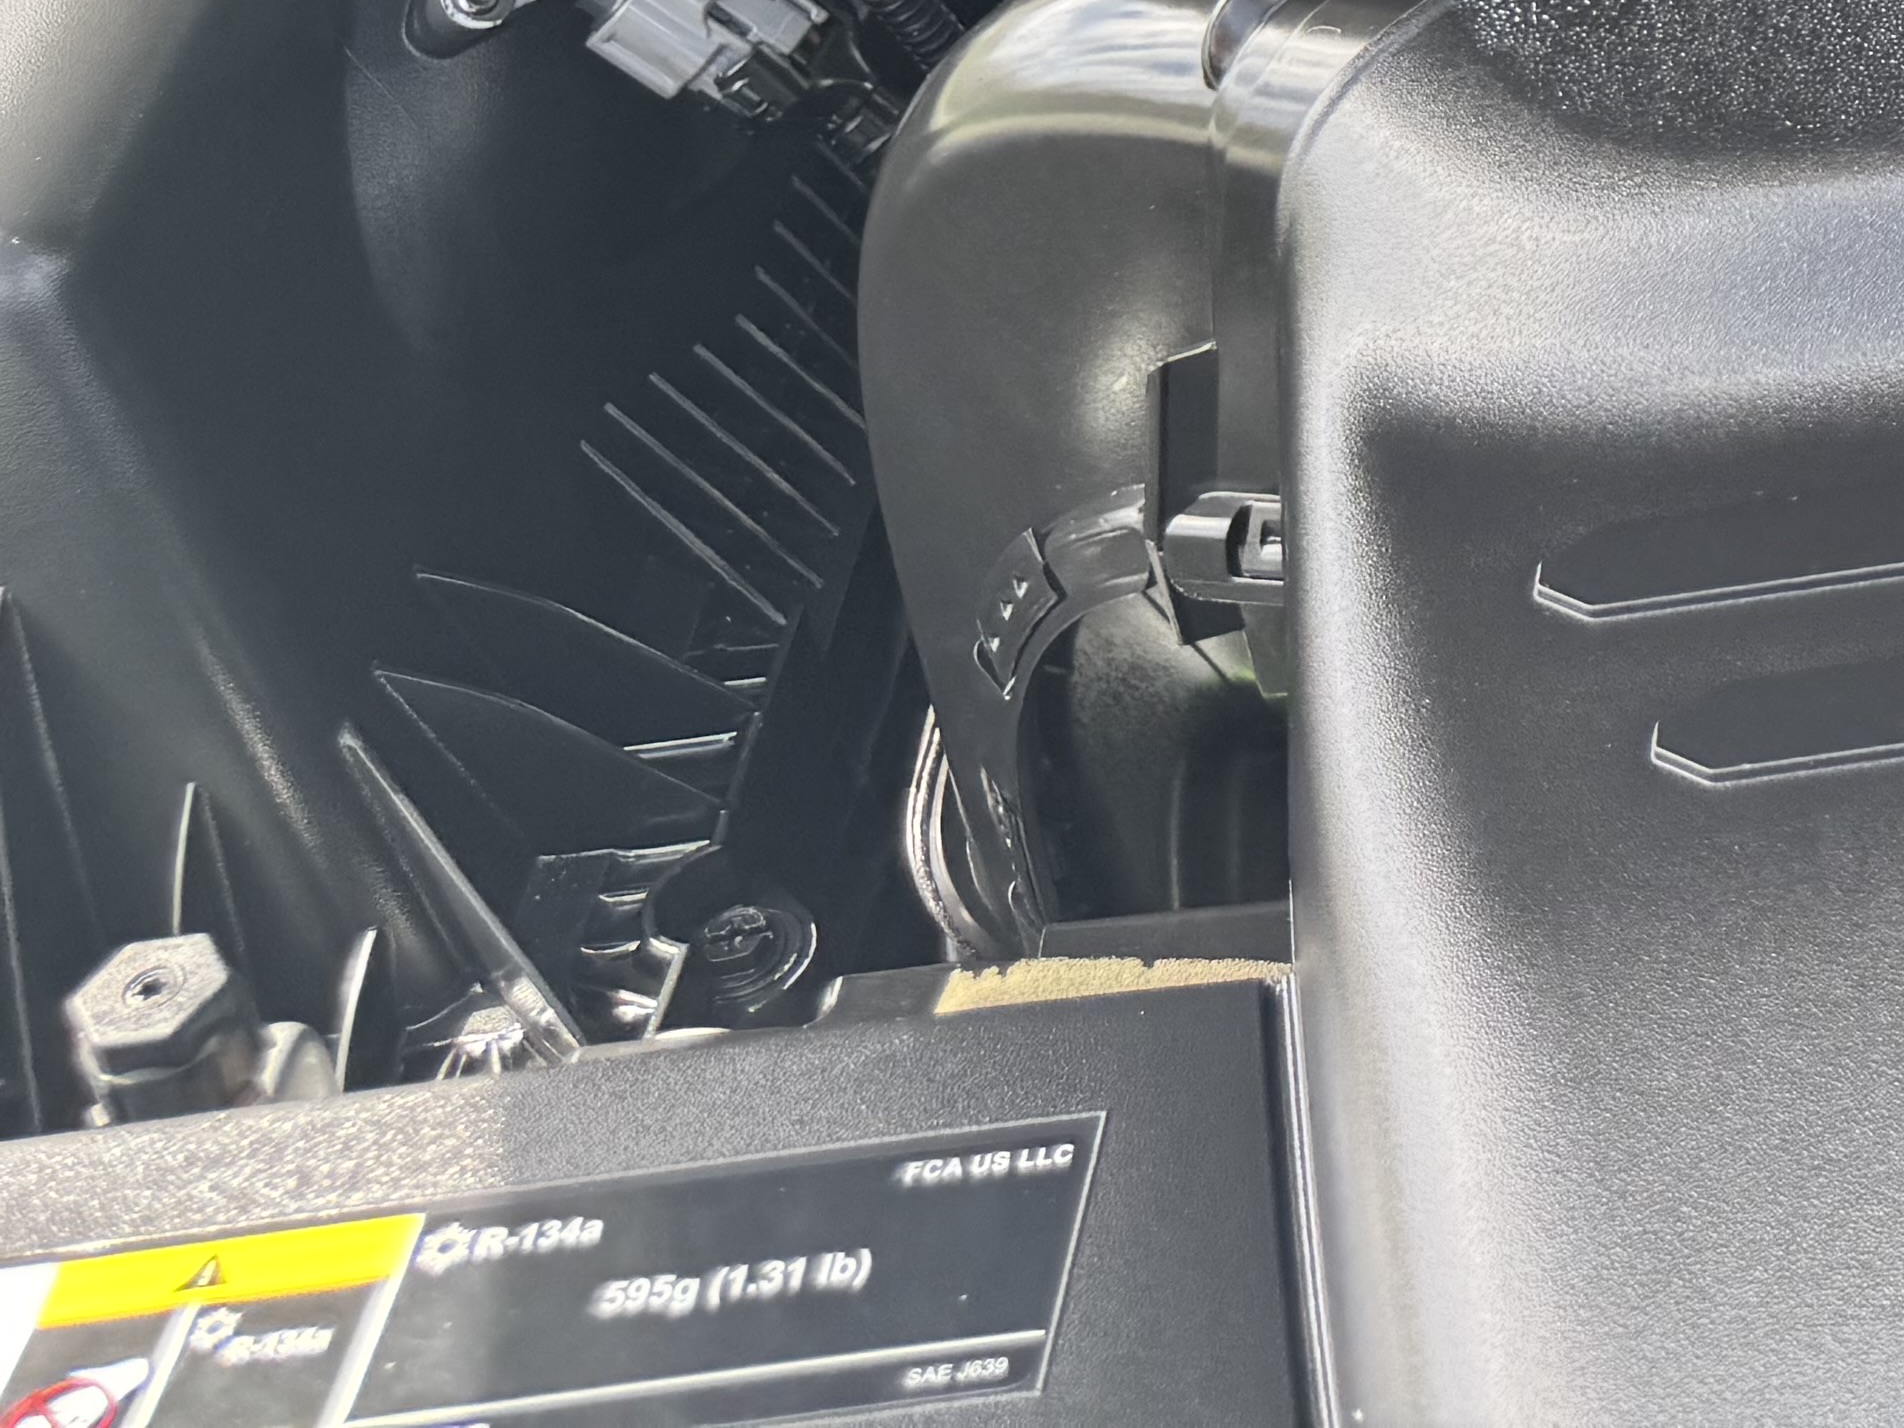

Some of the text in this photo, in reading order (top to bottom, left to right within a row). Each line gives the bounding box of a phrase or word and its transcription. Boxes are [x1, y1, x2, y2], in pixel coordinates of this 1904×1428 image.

[901, 1143, 1076, 1187] FCA US LLC
[470, 1216, 605, 1264] R-134a
[592, 1247, 873, 1319] 595g (1.31 lb)
[902, 1356, 1010, 1390] SAE J639
